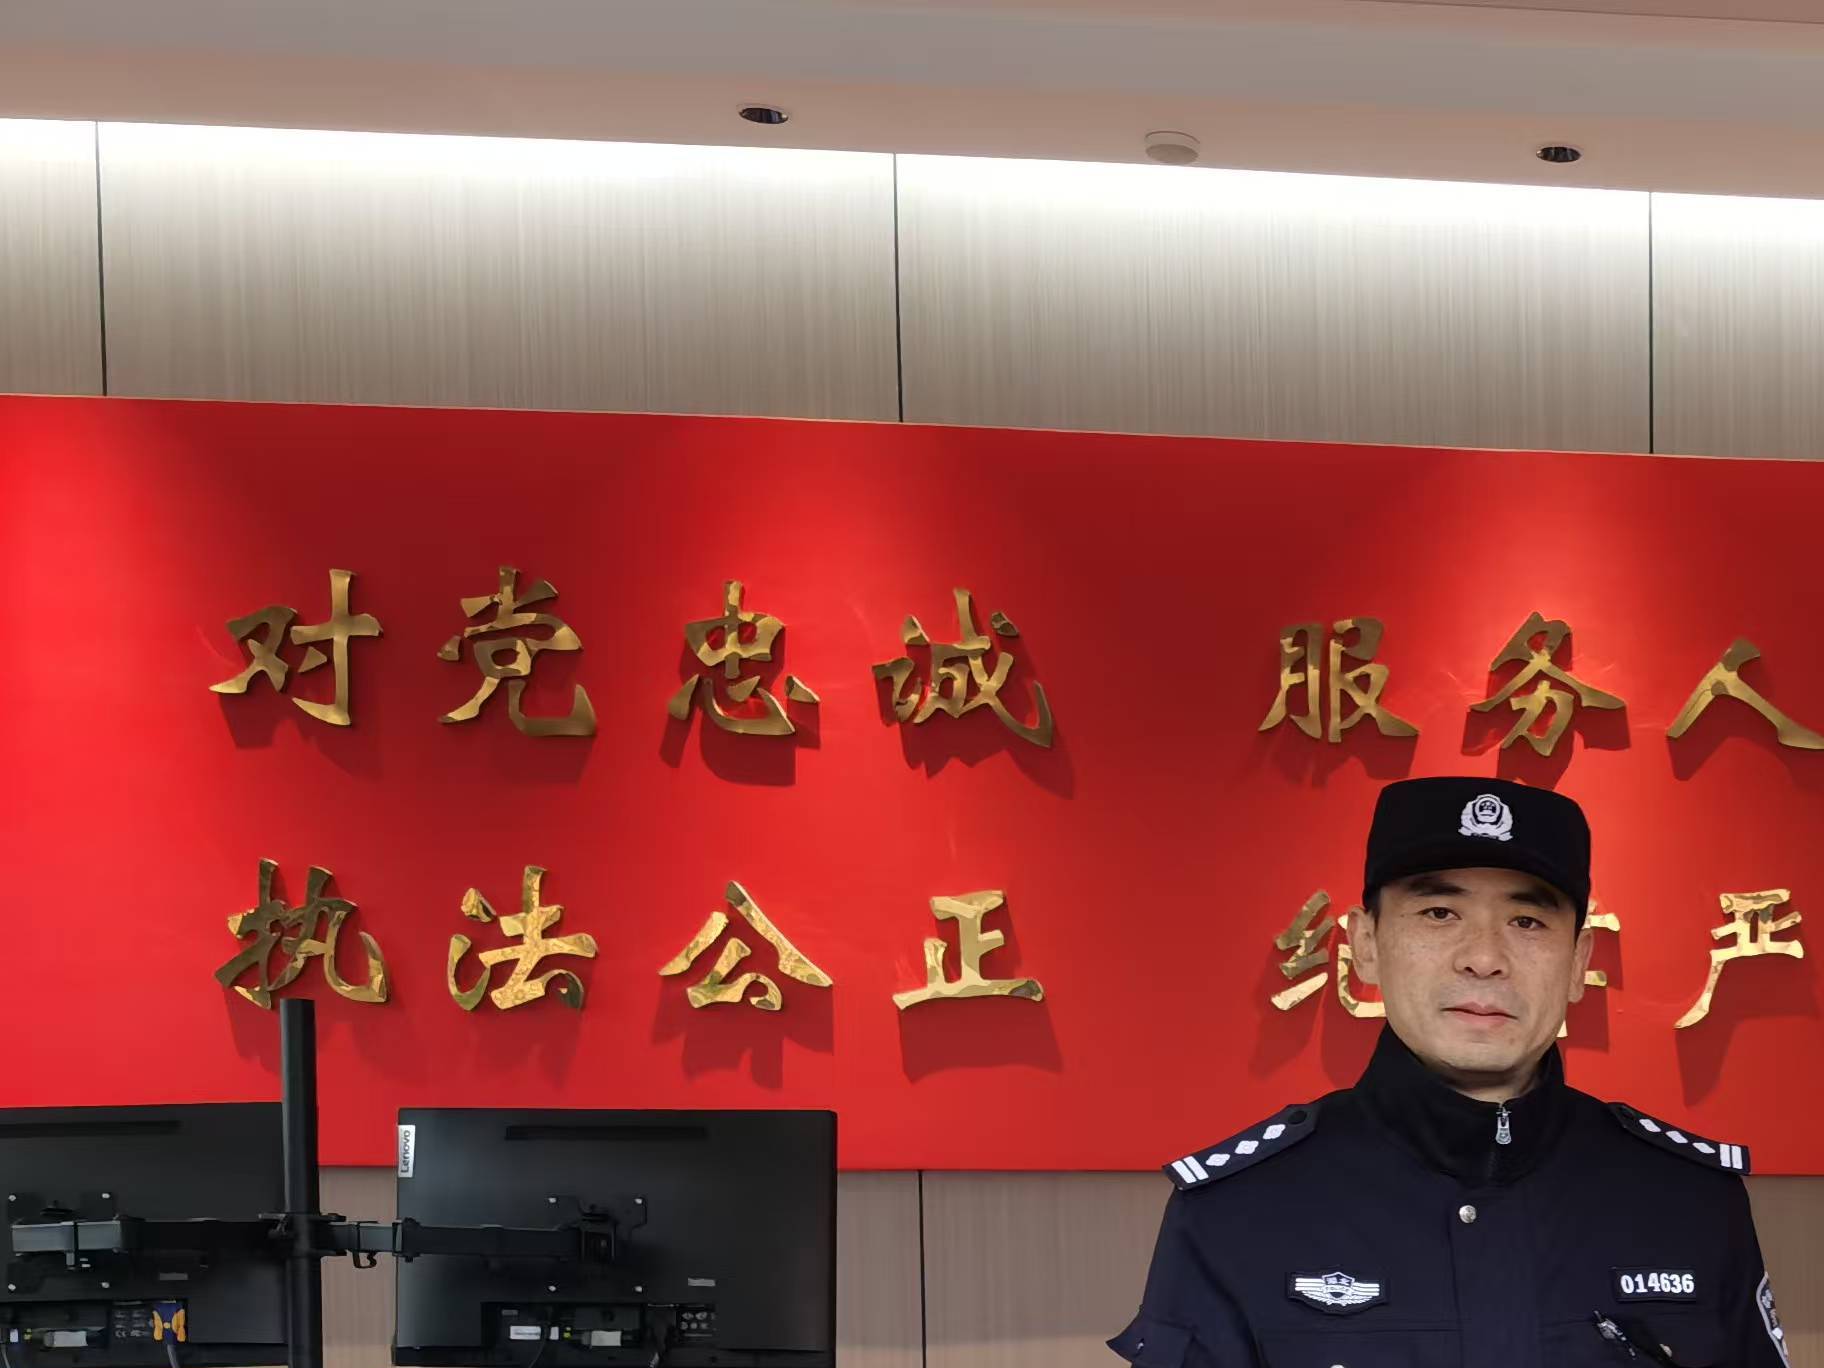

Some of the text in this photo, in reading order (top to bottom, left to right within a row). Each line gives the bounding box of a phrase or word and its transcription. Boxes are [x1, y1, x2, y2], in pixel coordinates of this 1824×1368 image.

[208, 565, 1055, 749] 对党忠诚
[213, 857, 1045, 1013] 执法公正
[400, 1129, 411, 1174] Lenovo
[1619, 1272, 1695, 1295] 014636
